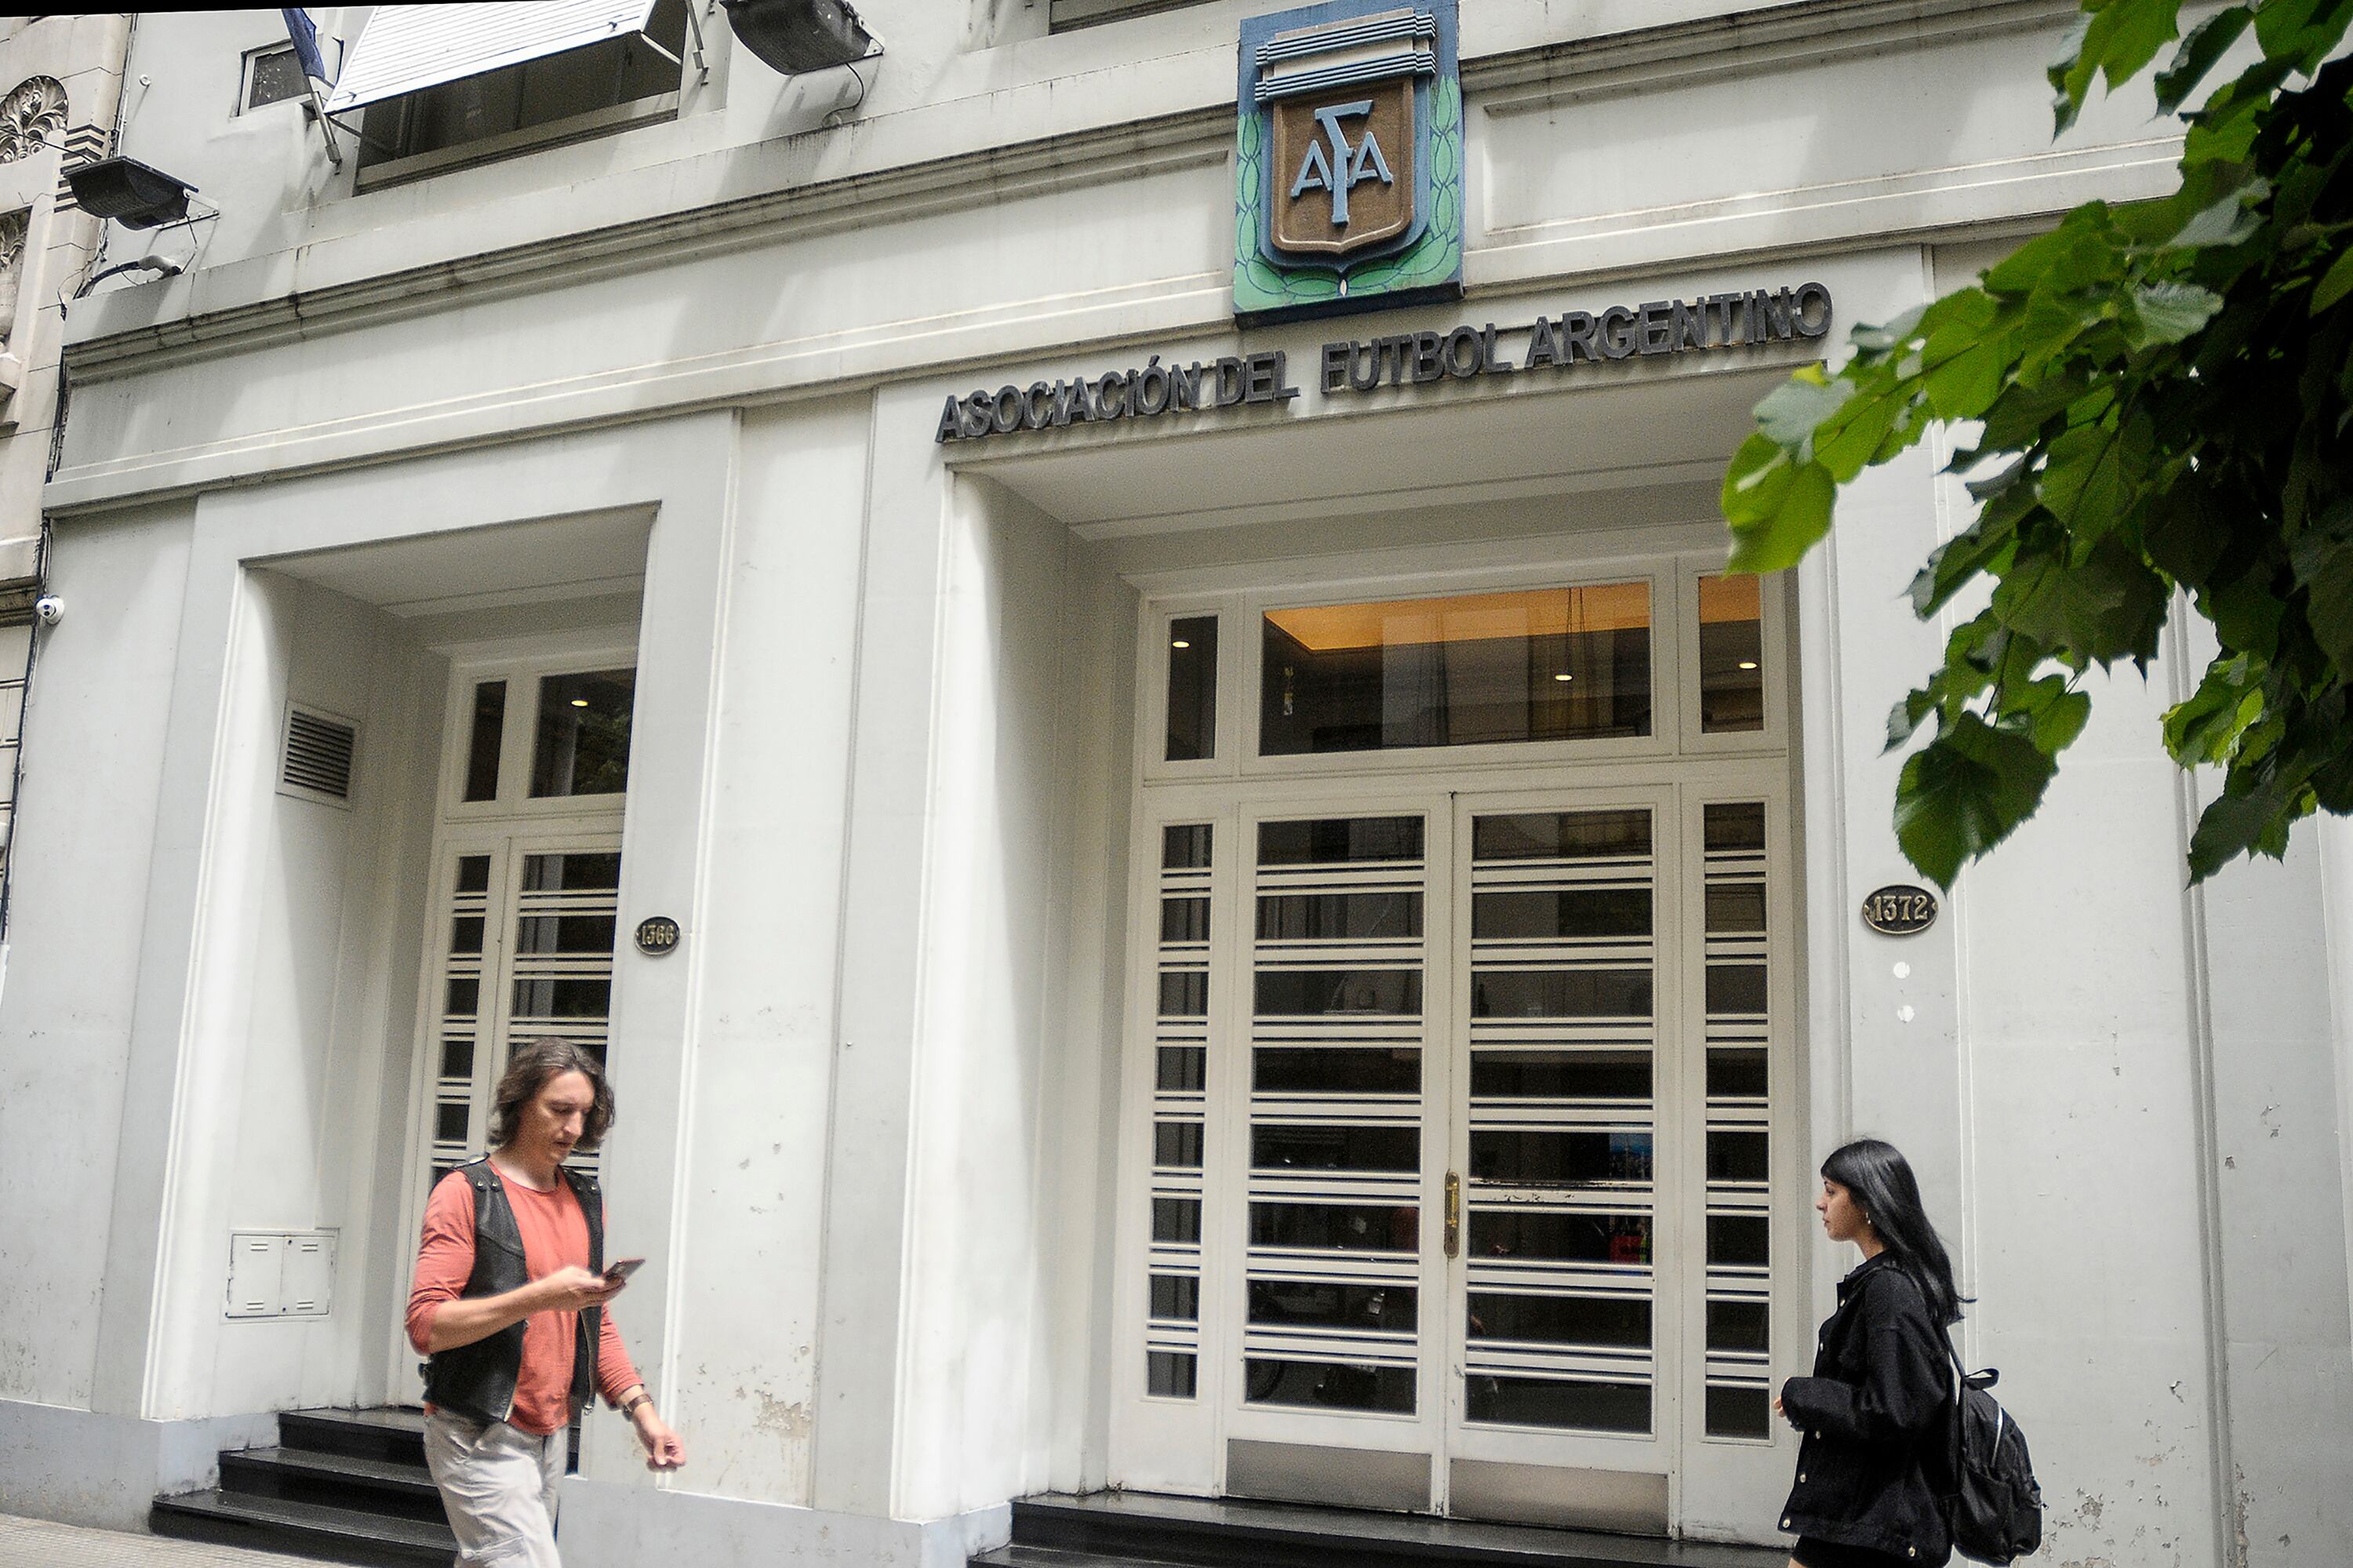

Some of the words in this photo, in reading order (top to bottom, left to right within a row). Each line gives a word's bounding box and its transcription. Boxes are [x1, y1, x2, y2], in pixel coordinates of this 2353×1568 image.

[1290, 100, 1394, 225] AFA
[936, 355, 1200, 442] ASOCIACIÓN
[1215, 350, 1300, 407] DEL
[1321, 323, 1513, 394] FUTBOL
[1525, 281, 1834, 369] ARGENTINO
[1874, 895, 1928, 922] 1372
